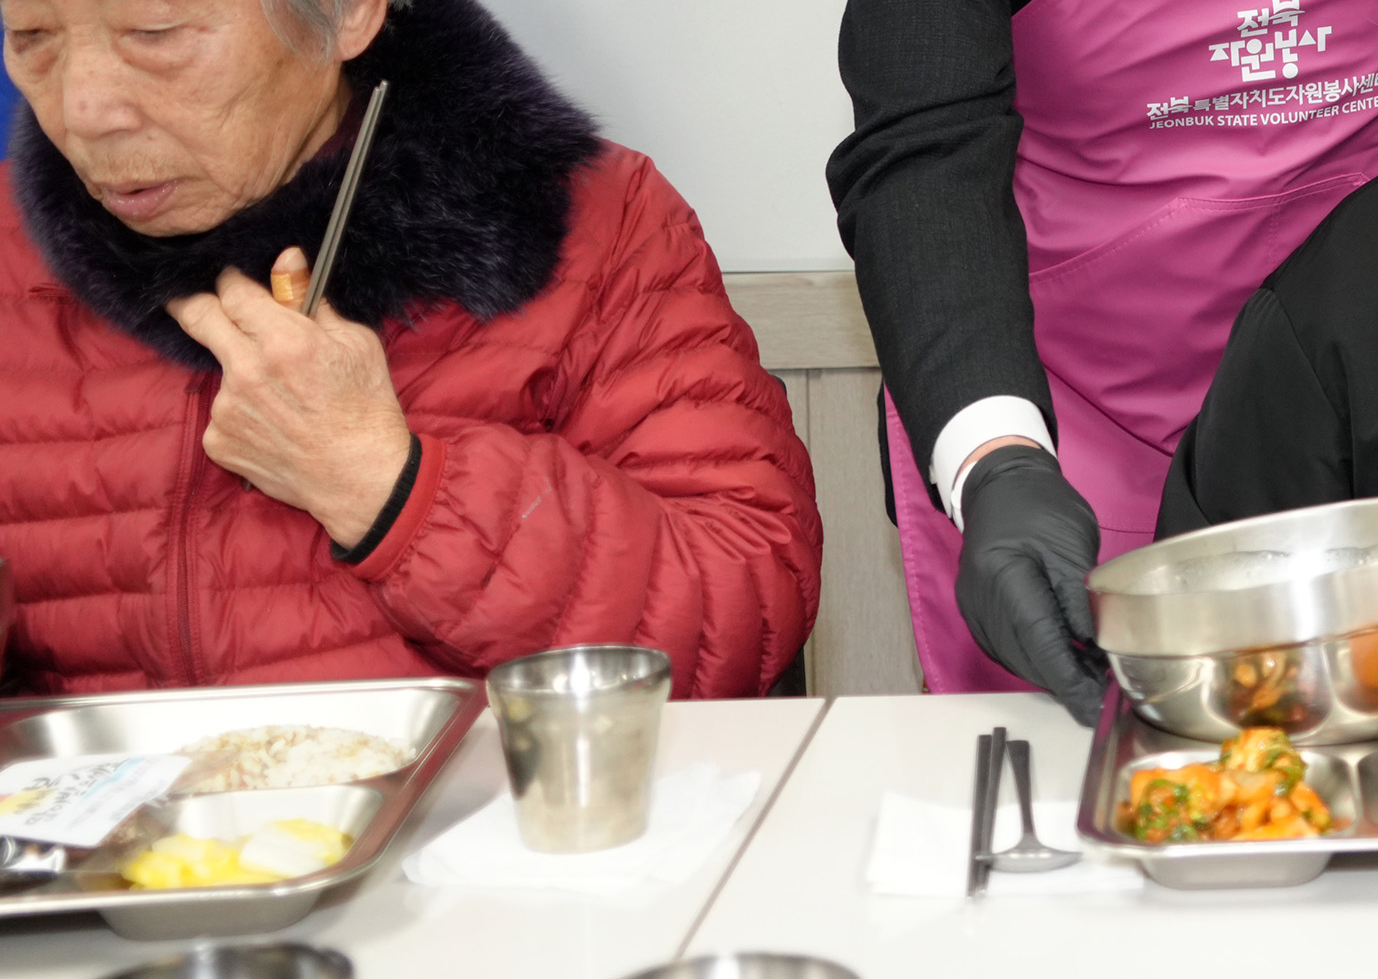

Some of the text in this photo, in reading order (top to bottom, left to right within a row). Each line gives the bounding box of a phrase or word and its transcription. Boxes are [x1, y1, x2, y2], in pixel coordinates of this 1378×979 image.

[1209, 26, 1332, 82] 자원봉사
[1149, 116, 1214, 129] JEONBUK
[1217, 113, 1258, 126] STATE
[1260, 106, 1339, 125] VOLUNTEER
